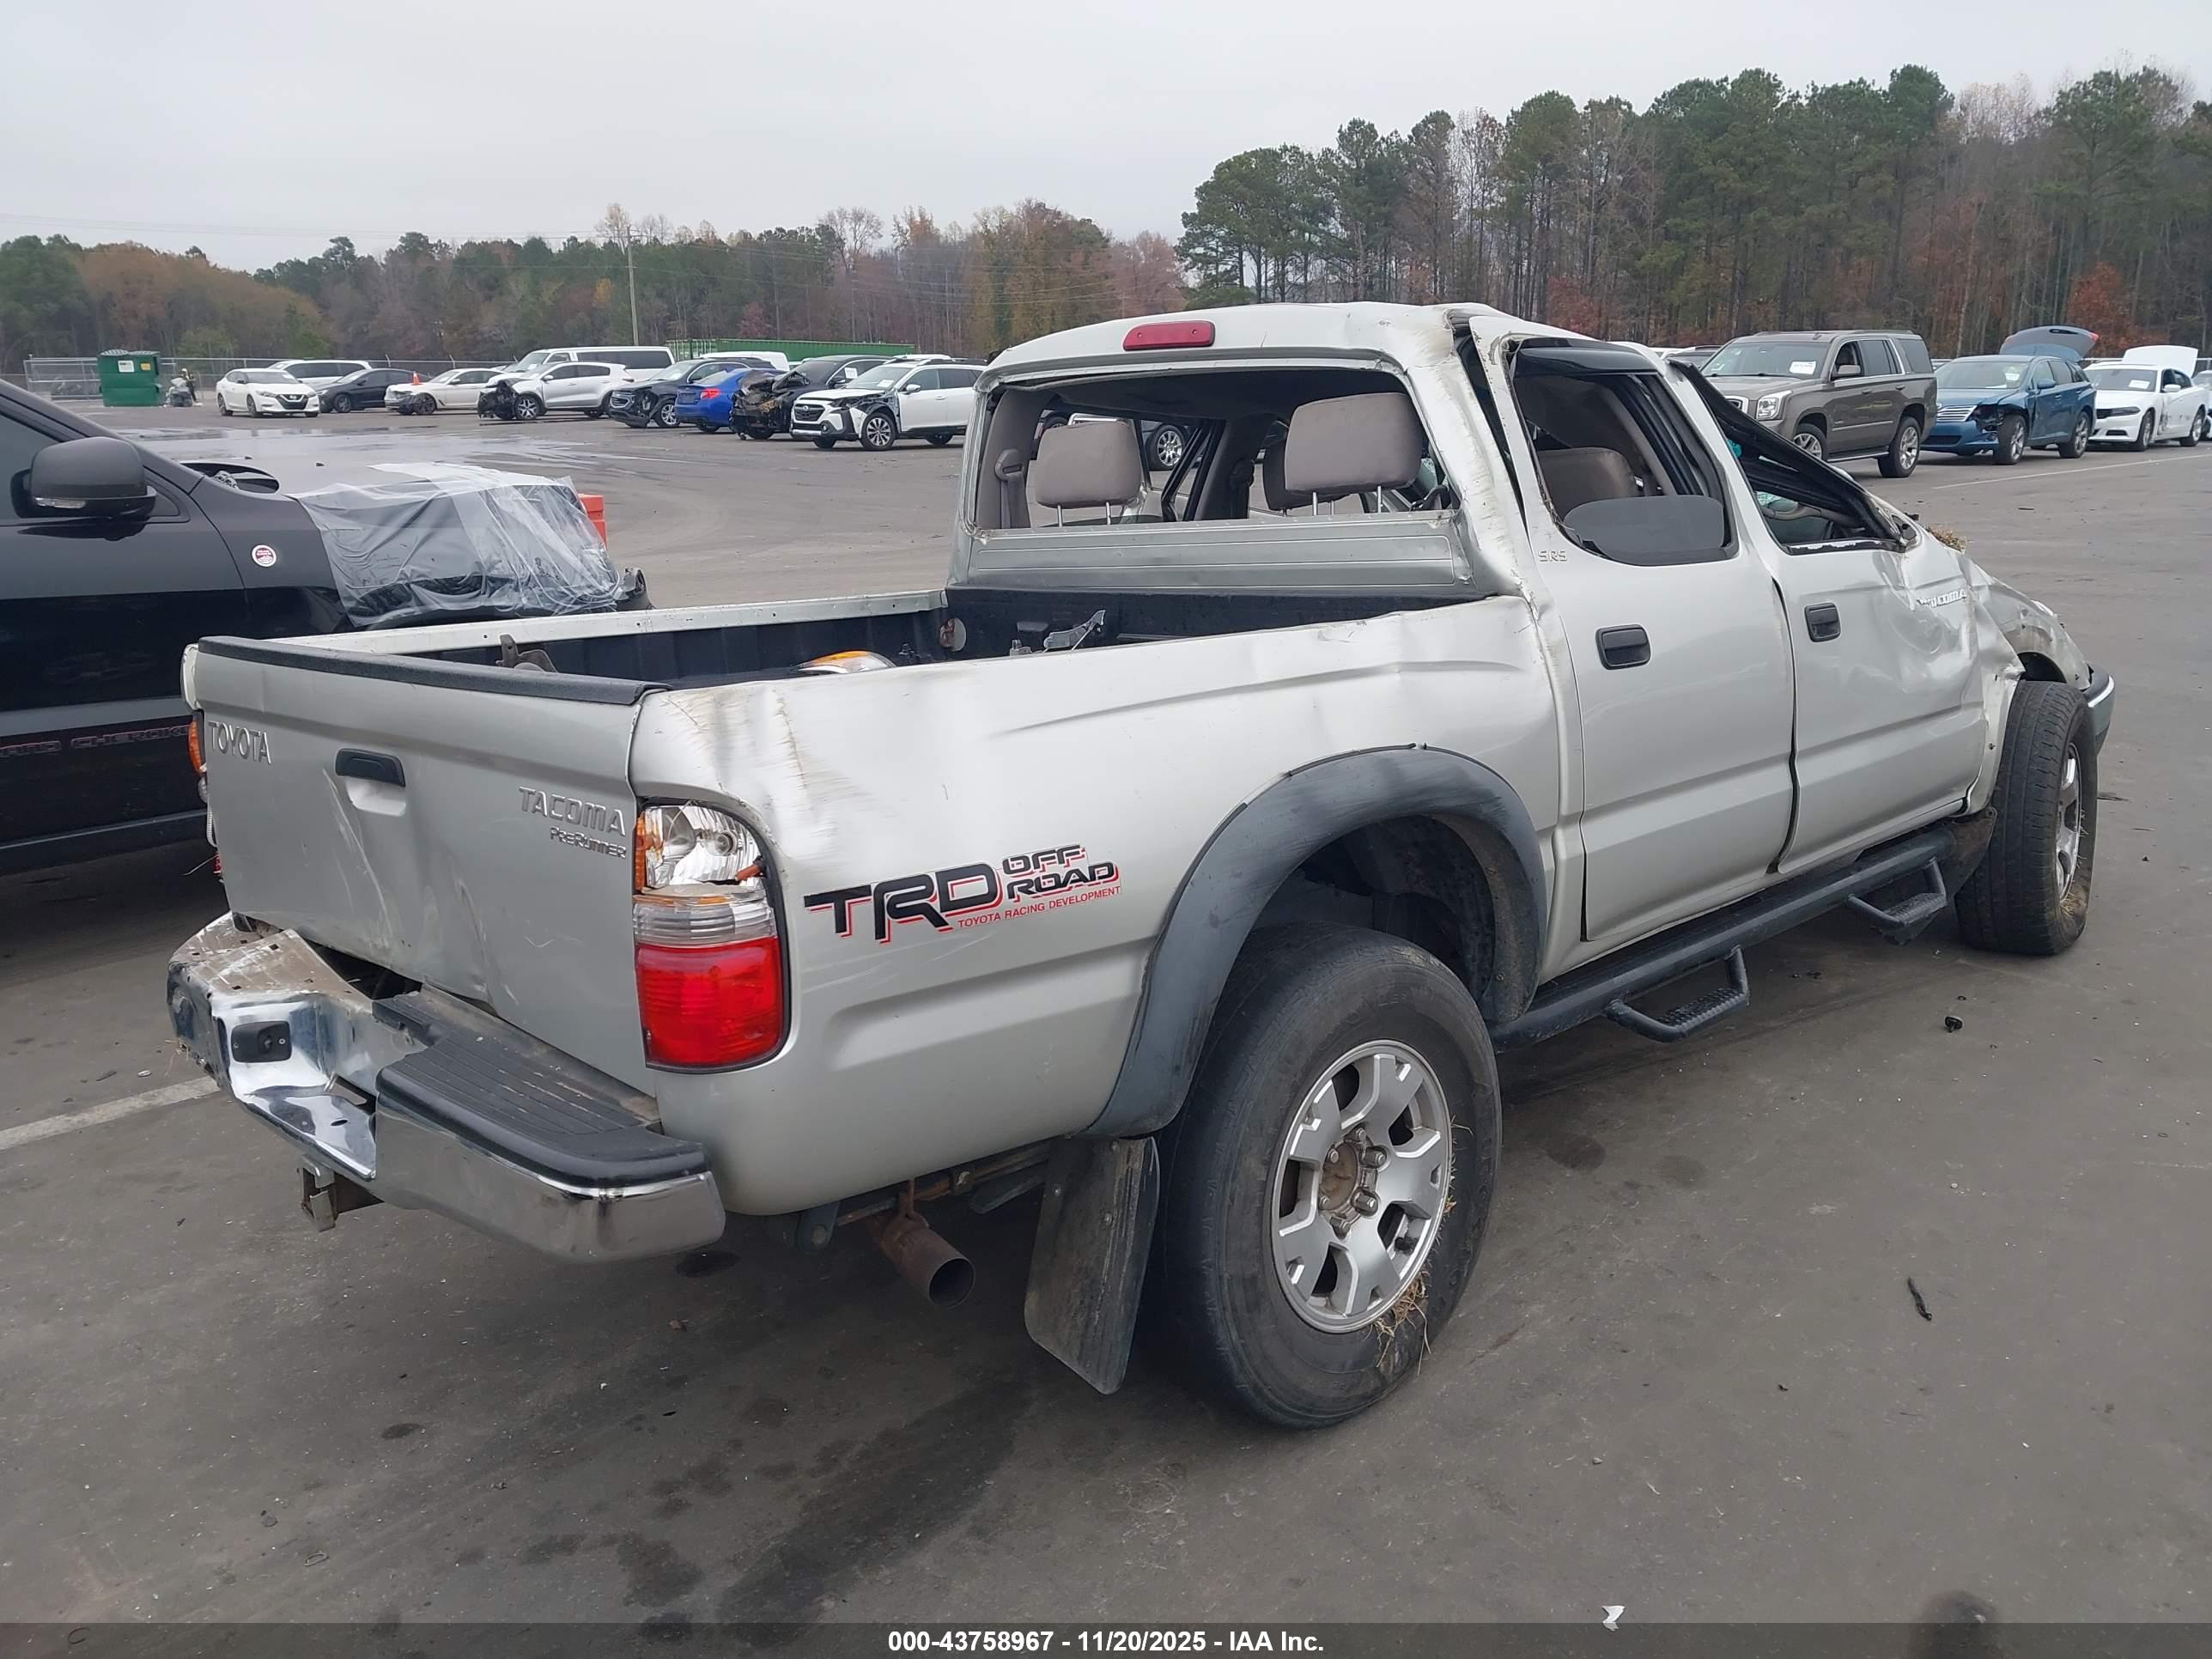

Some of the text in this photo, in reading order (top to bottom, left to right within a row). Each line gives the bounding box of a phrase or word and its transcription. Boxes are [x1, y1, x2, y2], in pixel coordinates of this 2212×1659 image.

[1538, 550, 1567, 562] SRS
[0, 740, 62, 758] AND
[207, 720, 271, 765] TOYOTA
[518, 786, 626, 836] TACOMA
[1001, 844, 1086, 878] OFF
[1006, 860, 1120, 902] ROAD
[804, 862, 1003, 944] TRD
[957, 885, 1121, 929] TOYOTA RACING DEVELOPMENT
